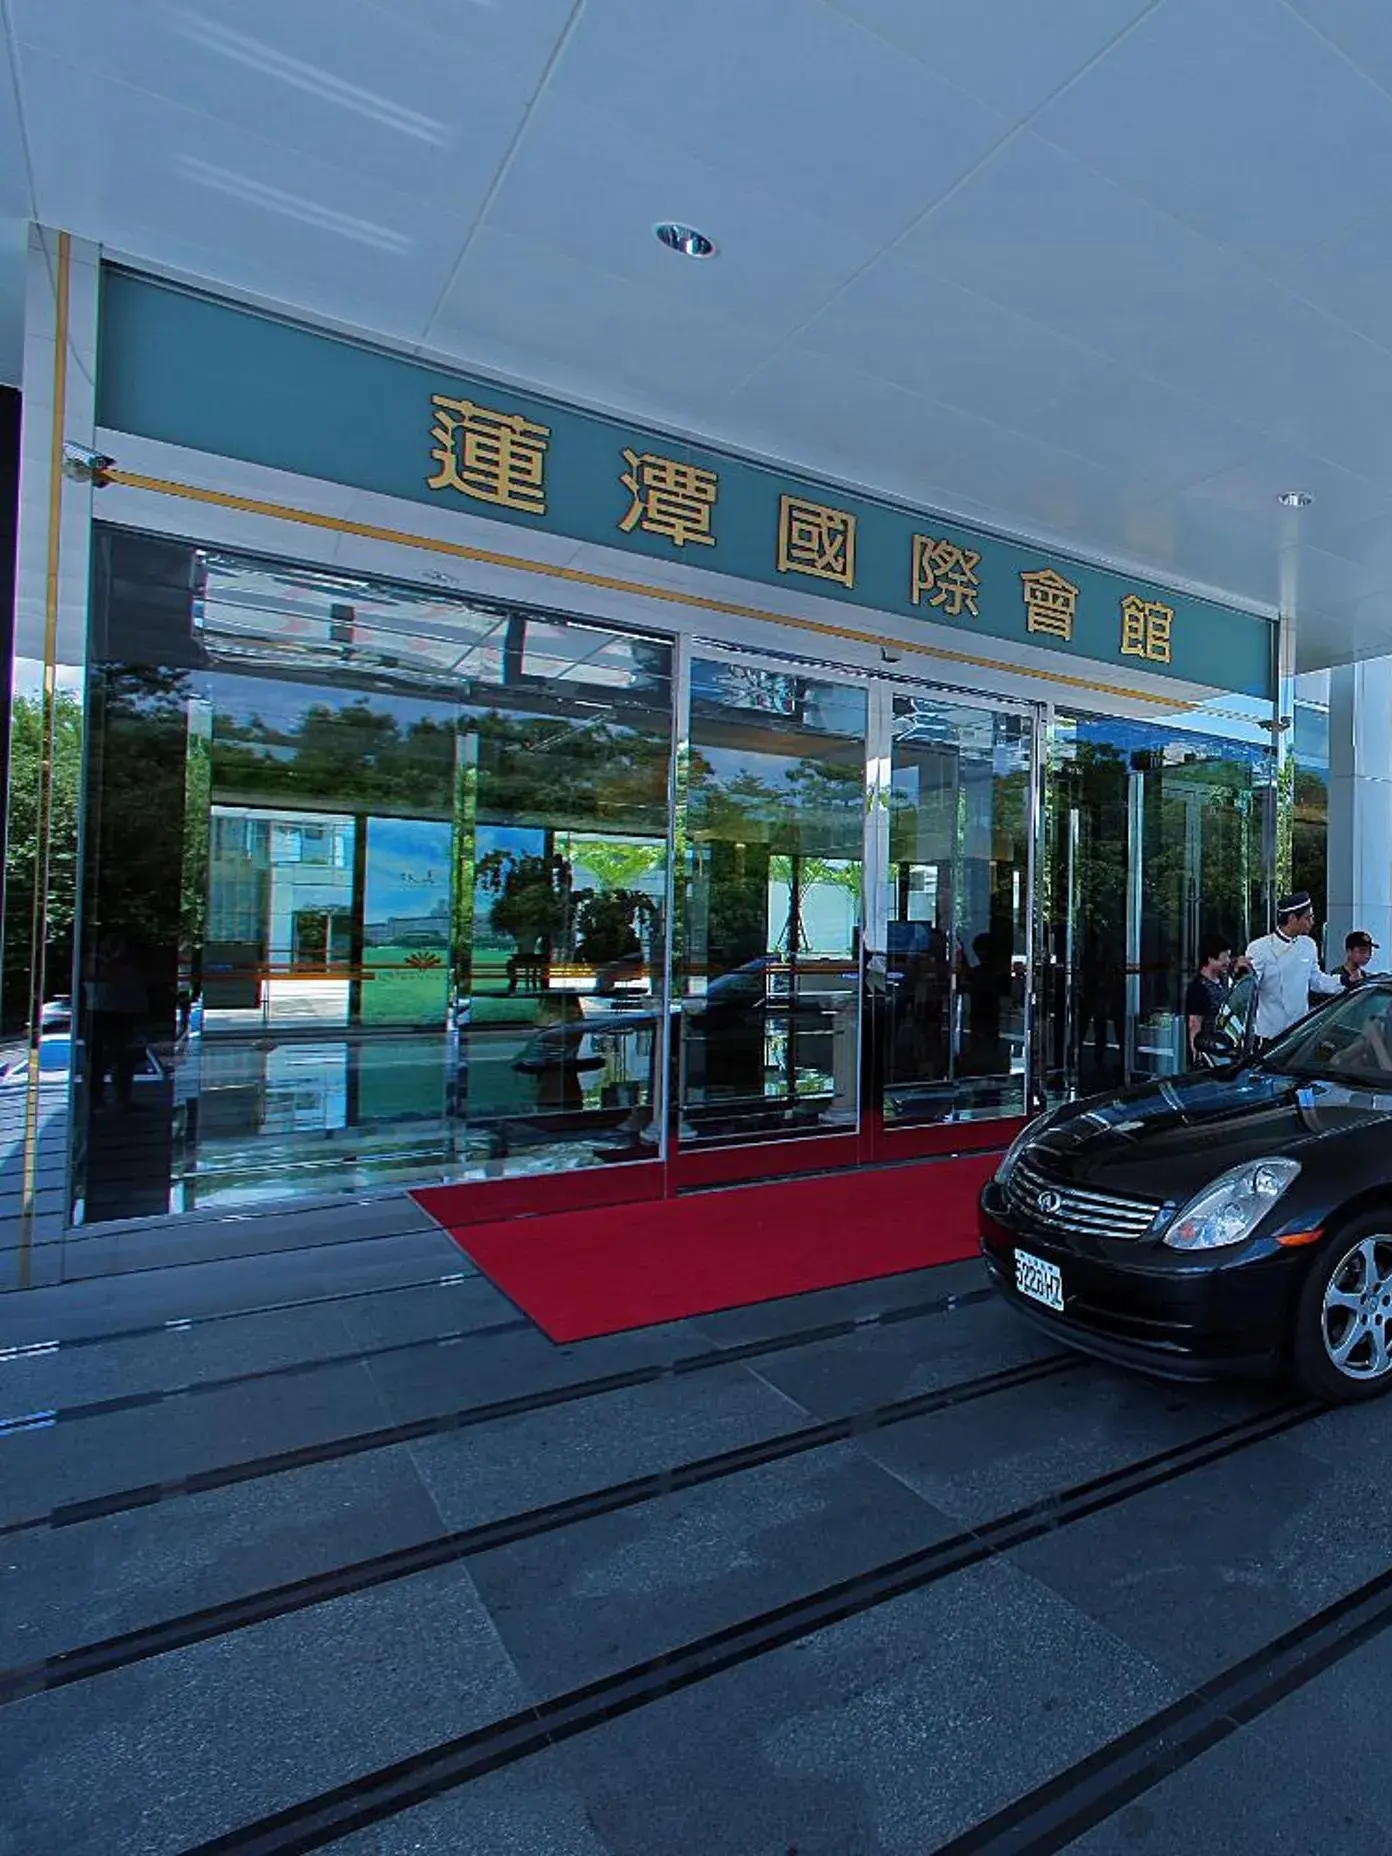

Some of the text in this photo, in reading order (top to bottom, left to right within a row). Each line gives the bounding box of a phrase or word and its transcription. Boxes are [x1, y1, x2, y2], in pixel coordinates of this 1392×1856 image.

[427, 394, 1174, 664] 蓮潭國際會館
